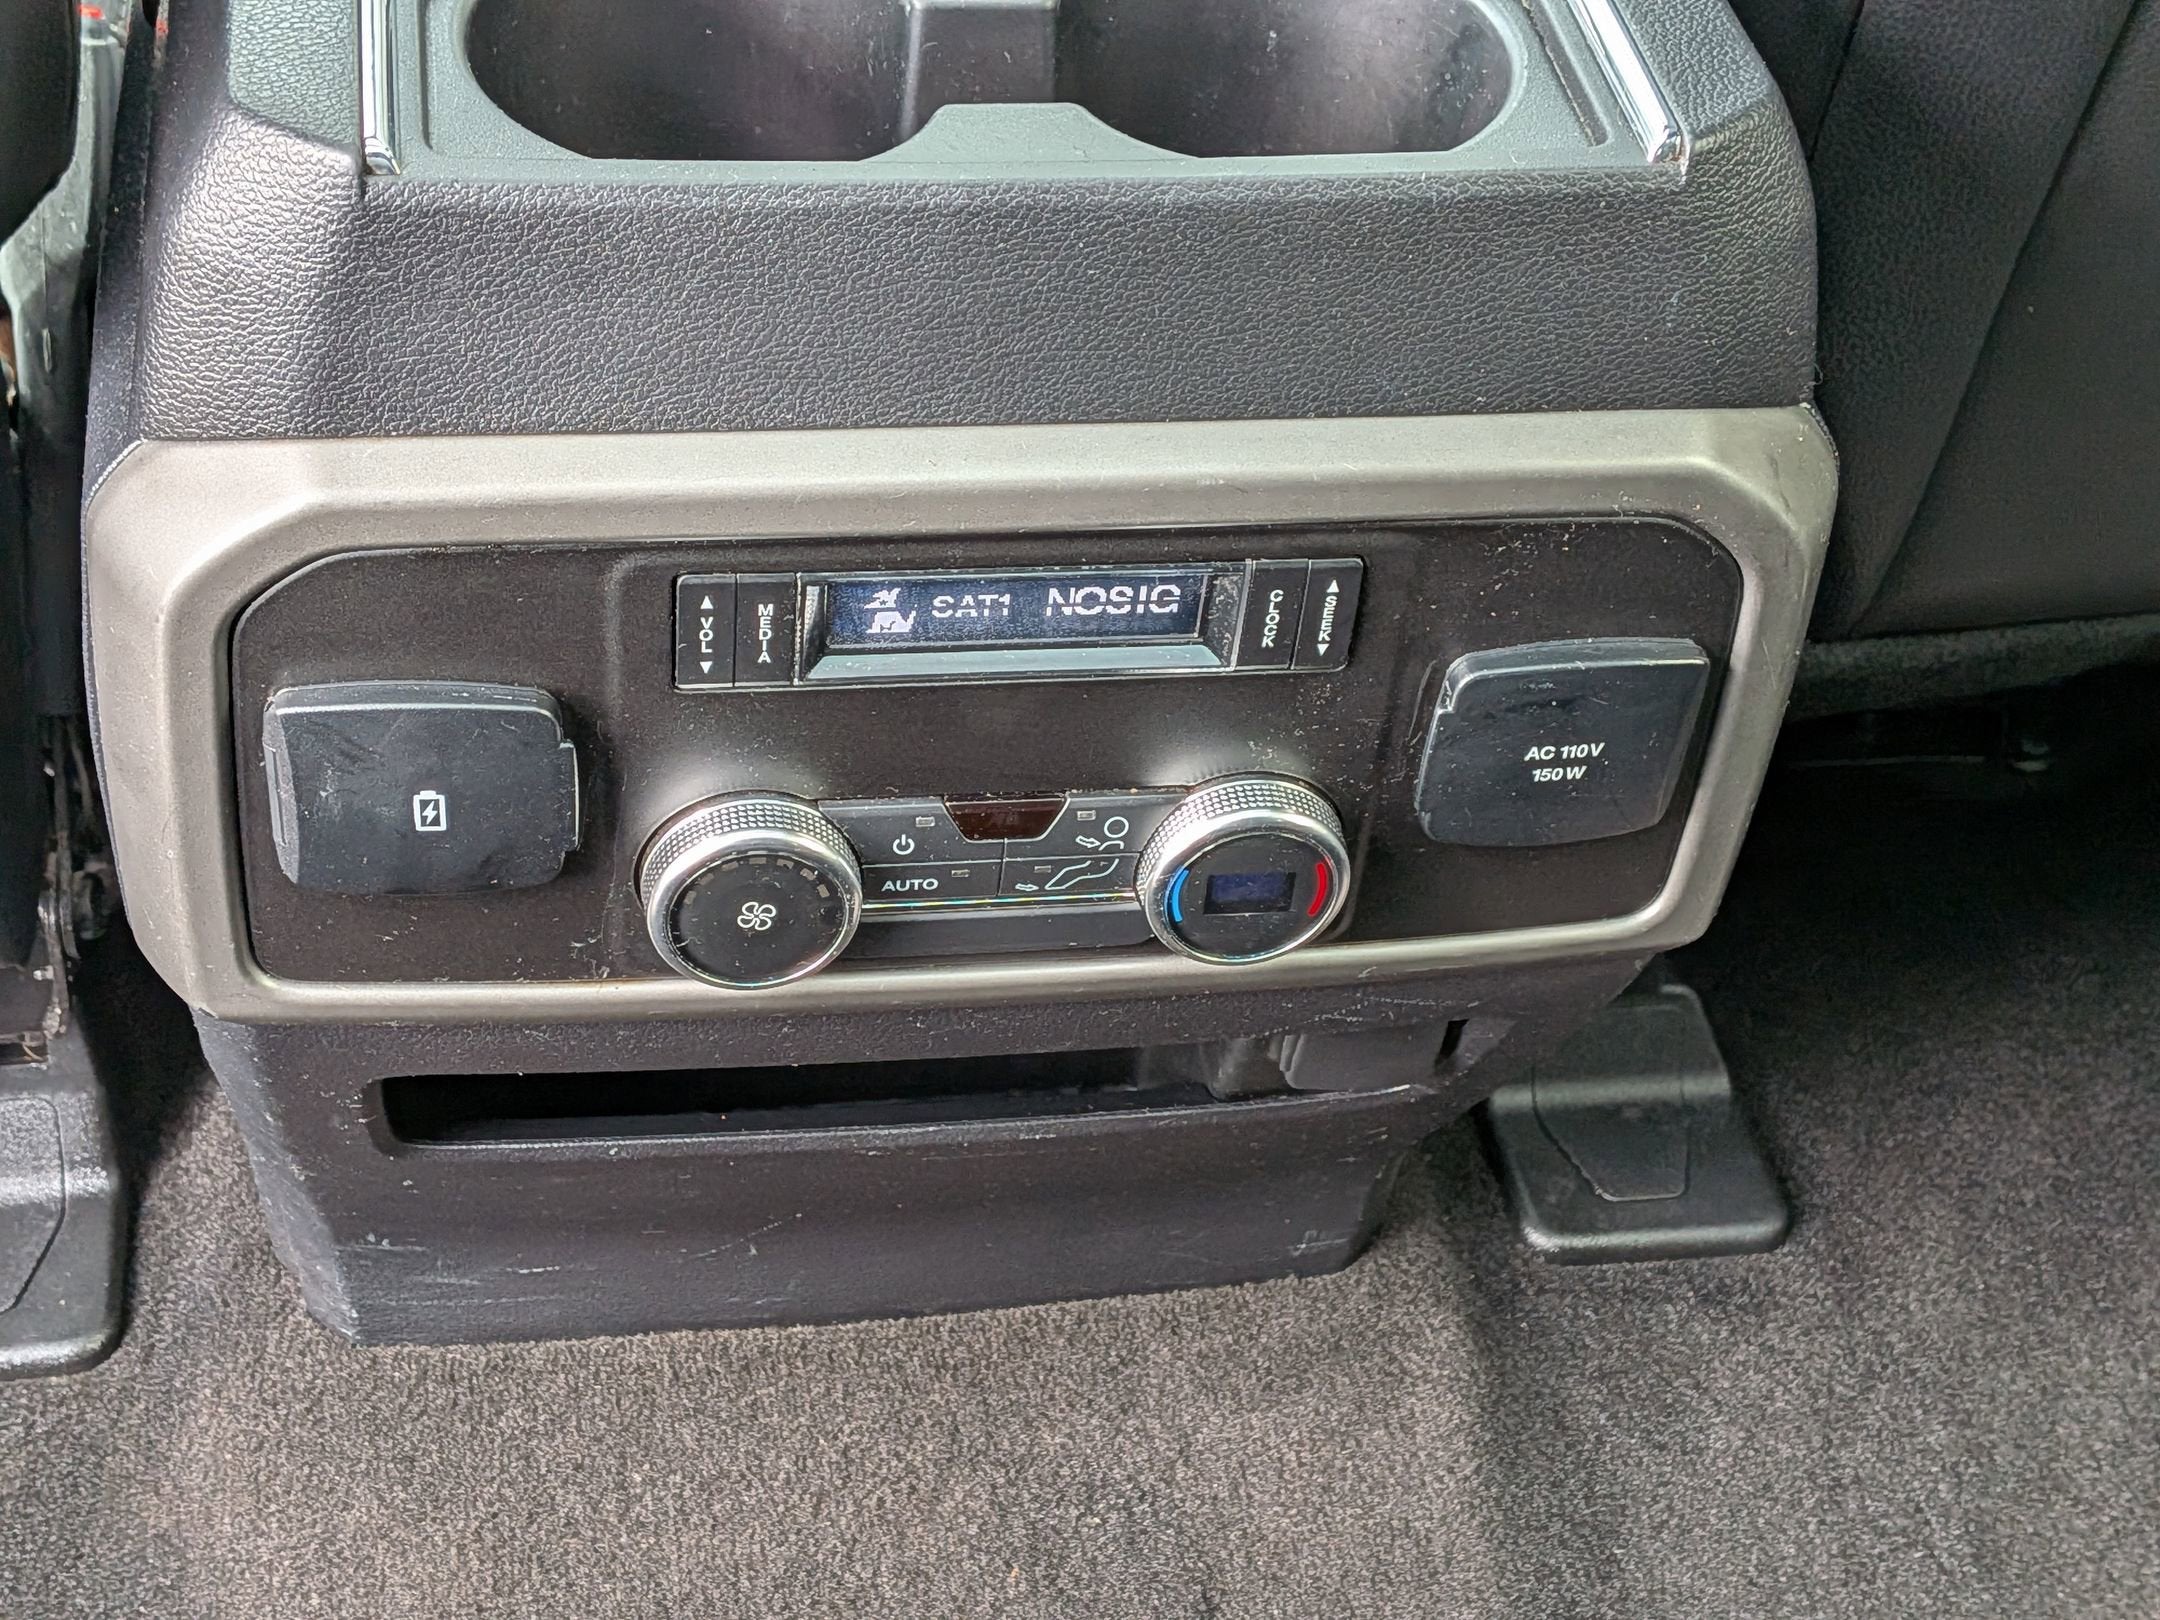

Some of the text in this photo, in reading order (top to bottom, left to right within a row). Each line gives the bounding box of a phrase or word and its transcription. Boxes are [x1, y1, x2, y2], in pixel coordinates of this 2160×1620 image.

[931, 584, 1182, 618] SAT1 NOSIG
[1261, 589, 1284, 648] CLOCK
[1318, 595, 1338, 642] SEEK
[699, 616, 714, 654] VOL
[757, 603, 774, 664] MEDIA
[1523, 745, 1557, 761] AC
[881, 878, 939, 892] AUTO
